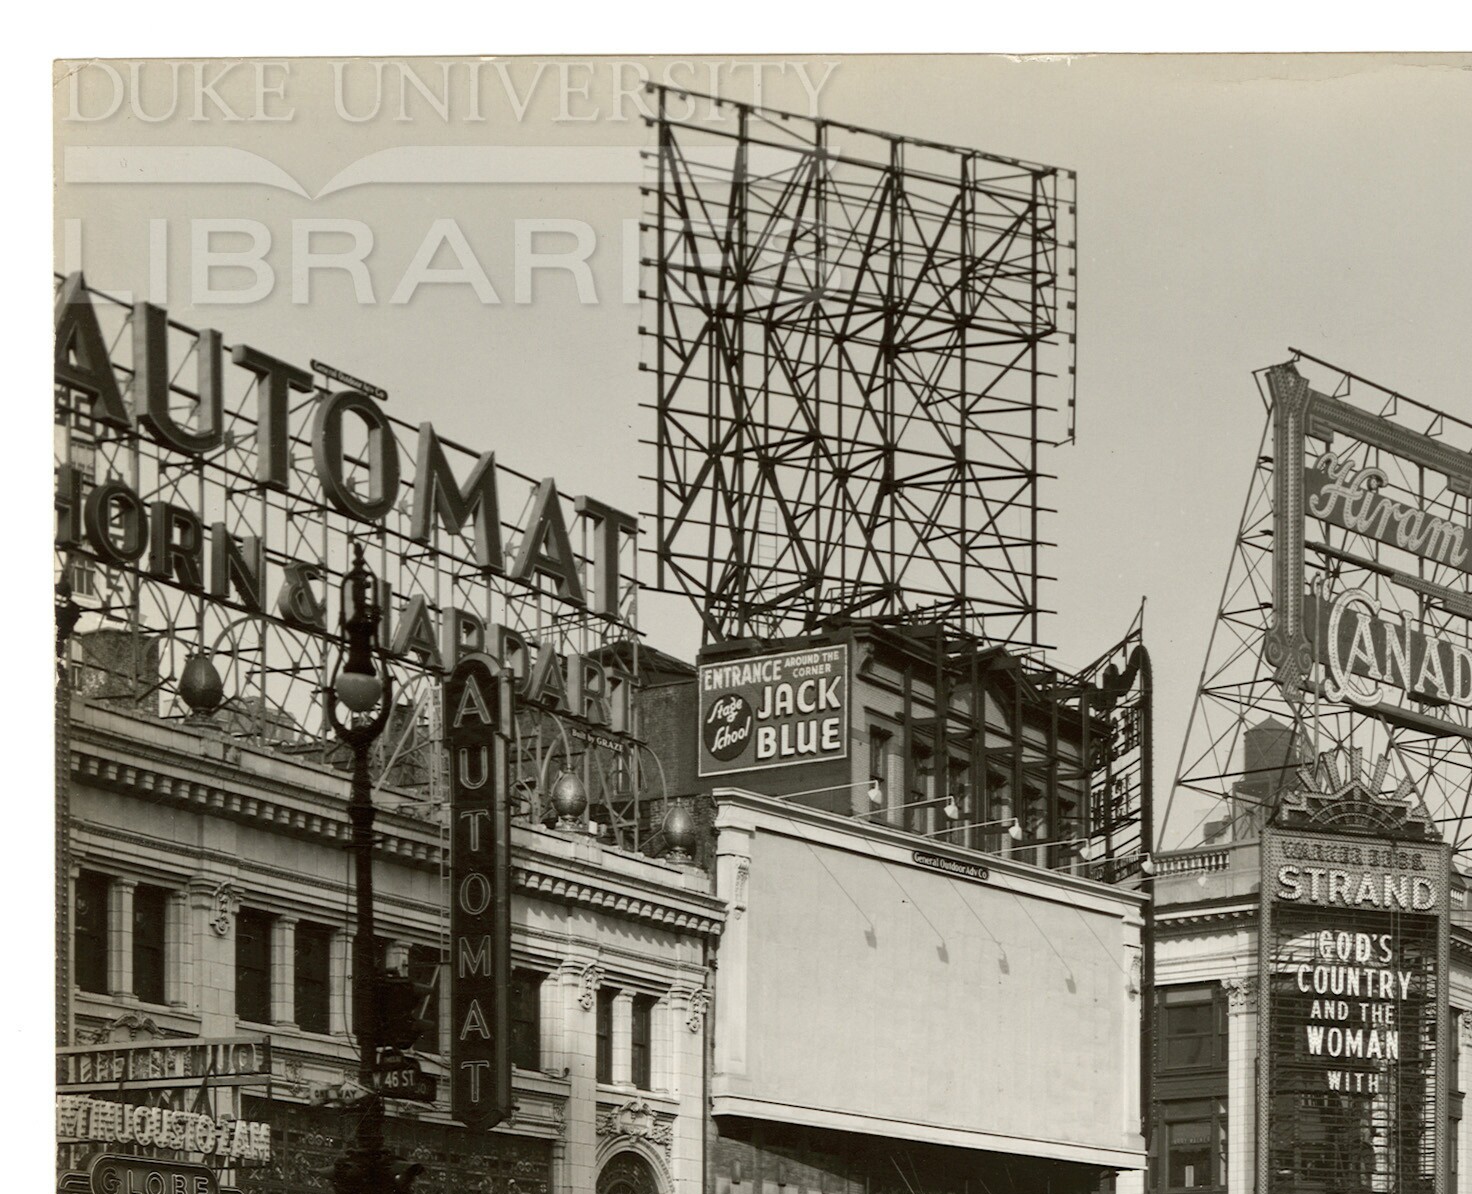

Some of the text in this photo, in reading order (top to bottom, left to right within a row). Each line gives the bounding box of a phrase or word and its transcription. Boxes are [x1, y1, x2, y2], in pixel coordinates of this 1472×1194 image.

[55, 271, 639, 620] AUTOMAT
[1309, 452, 1468, 567] Hiram
[704, 660, 782, 691] ENTRANCE
[784, 651, 839, 668] AROUND THE
[792, 664, 831, 678] CORNER
[707, 697, 743, 723] Stage
[757, 676, 841, 720] JACK
[711, 716, 751, 753] School
[757, 717, 841, 759] BLUE
[914, 853, 938, 866] General
[939, 857, 965, 873] Outdoor
[452, 674, 492, 1103] AUTOMAT
[1277, 864, 1437, 911] STRAND
[1319, 929, 1392, 963] GOD'S
[1297, 964, 1412, 1001] COUNTRY
[1310, 1000, 1395, 1024] AND THE
[1307, 1025, 1399, 1060] WOMAN
[384, 1071, 399, 1088] 46
[402, 1070, 414, 1087] ST
[1327, 1070, 1380, 1093] WITH
